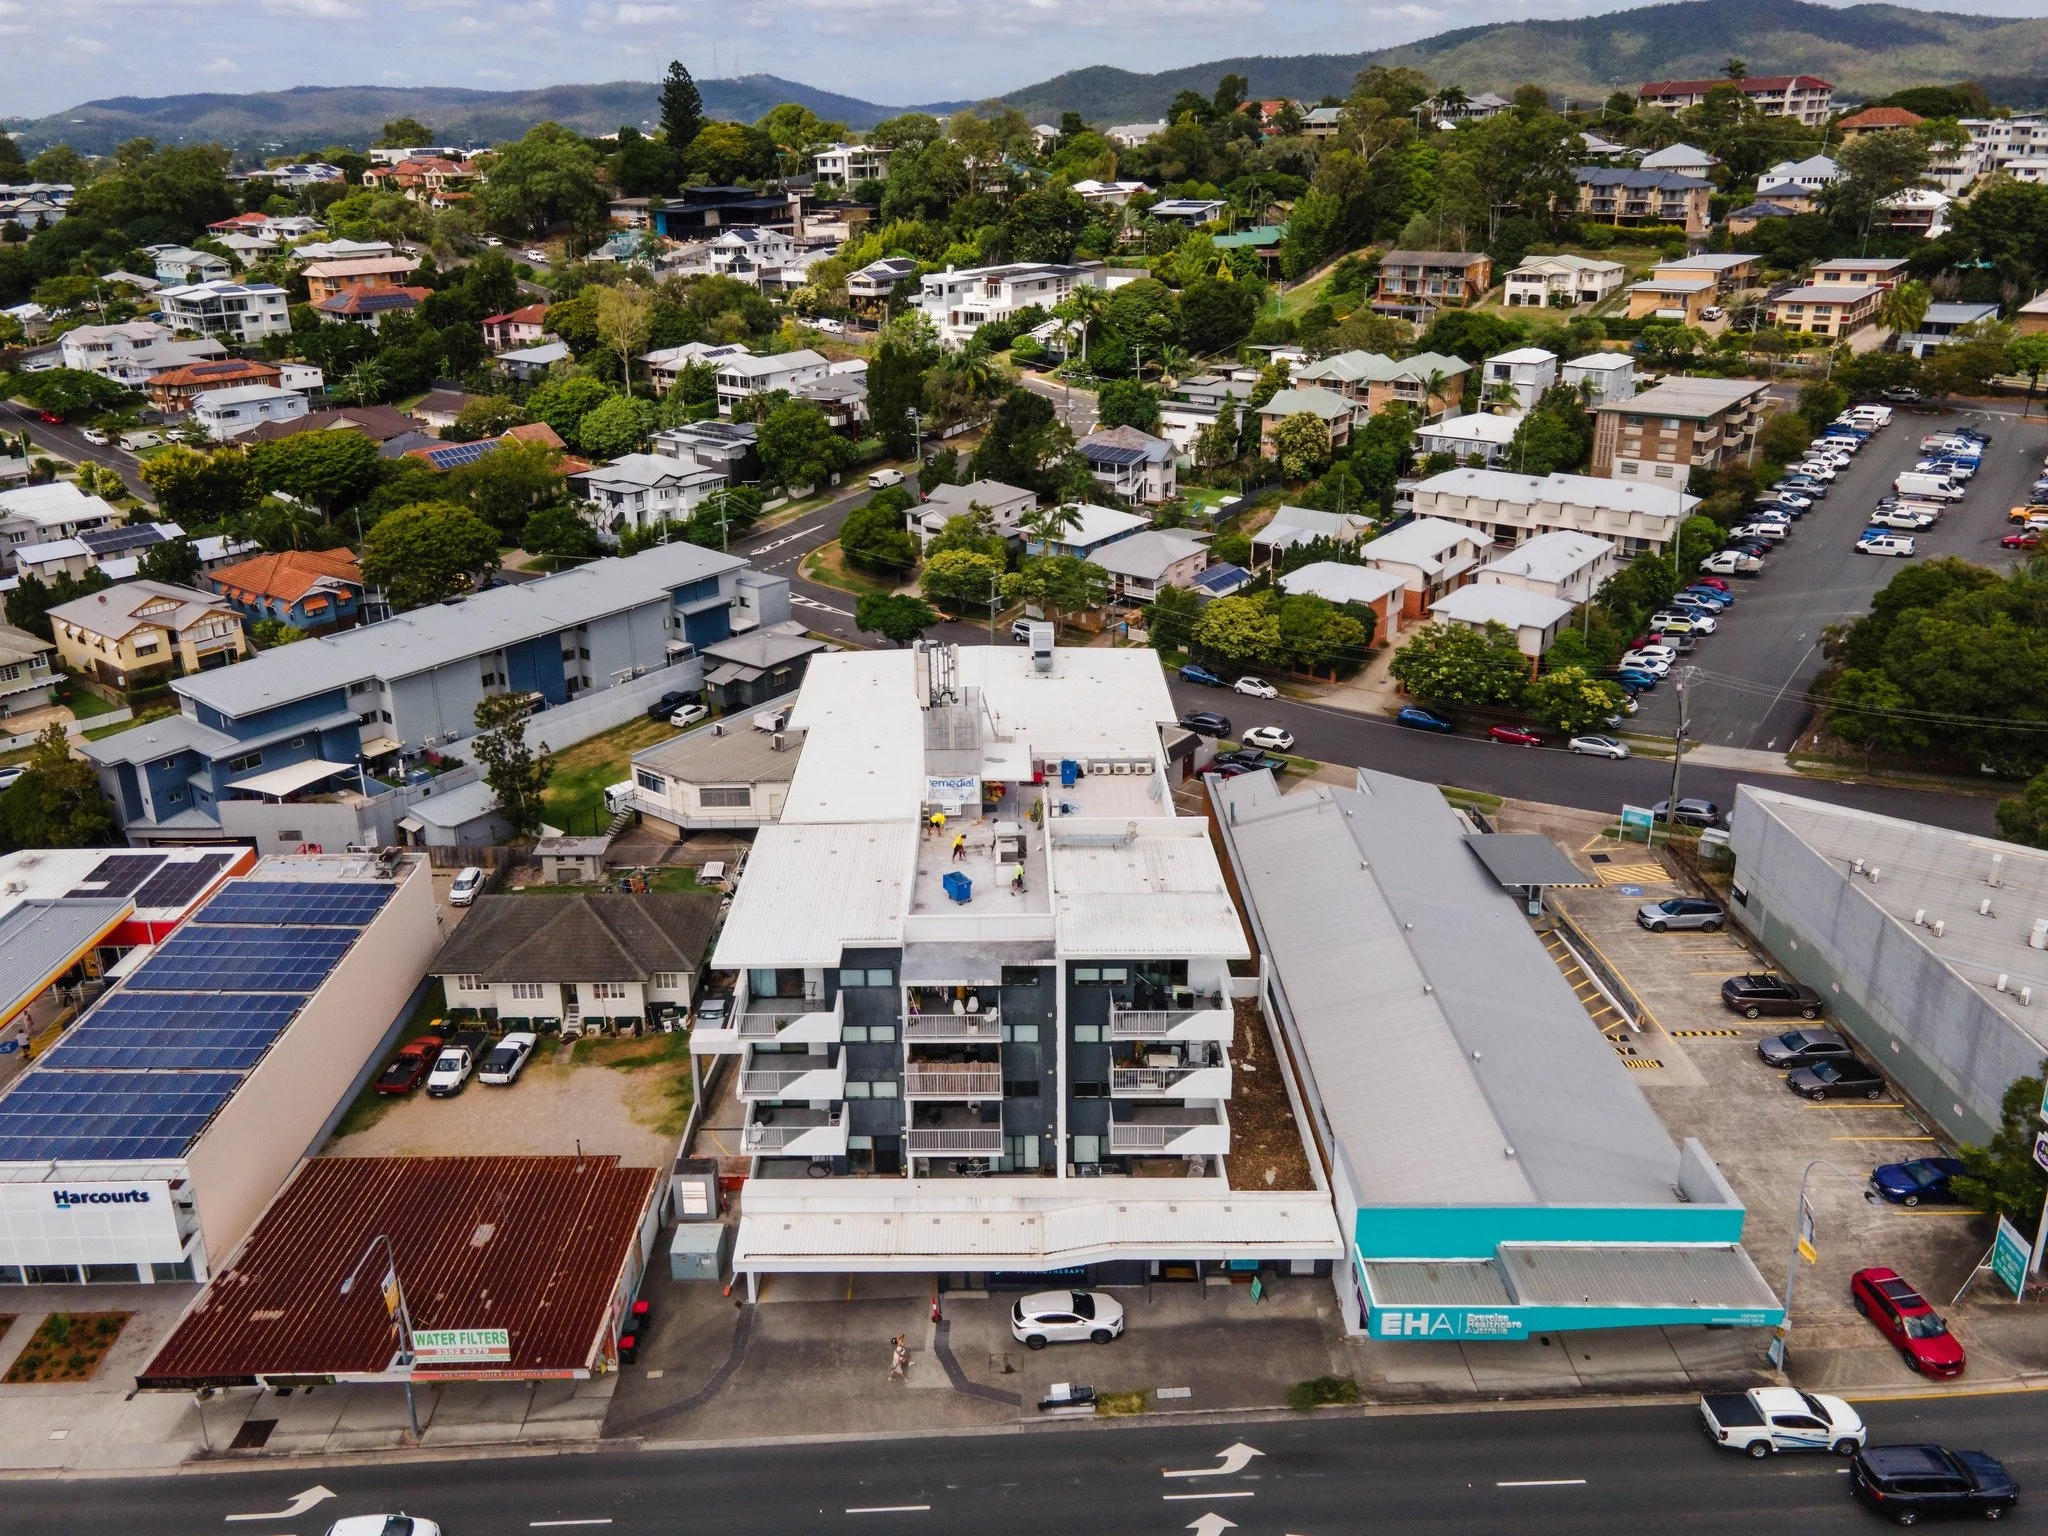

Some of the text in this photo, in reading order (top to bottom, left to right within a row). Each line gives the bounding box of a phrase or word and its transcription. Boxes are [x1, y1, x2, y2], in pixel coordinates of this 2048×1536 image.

[53, 1189, 150, 1205] Harcourts
[1380, 1313, 1454, 1335] EHA
[1466, 1320, 1522, 1329] Healthcare
[1467, 1313, 1509, 1322] Exercise
[414, 1331, 508, 1346] WATER FILTERS
